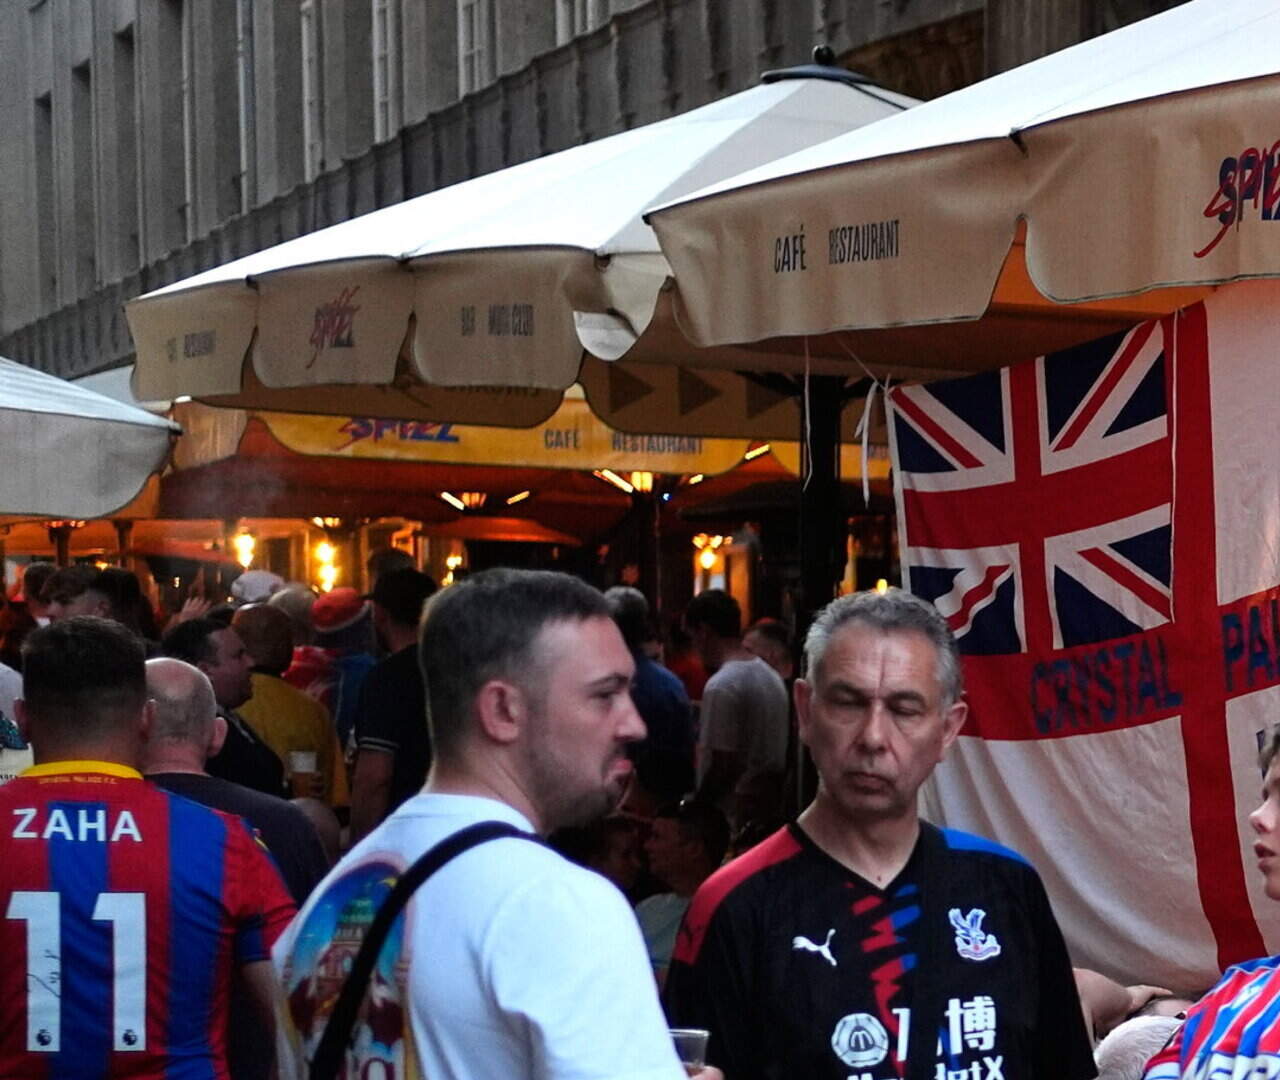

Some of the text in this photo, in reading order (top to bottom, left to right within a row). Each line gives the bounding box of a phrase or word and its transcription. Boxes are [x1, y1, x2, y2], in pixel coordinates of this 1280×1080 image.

[774, 219, 900, 274] CAFÉ RESTAURANT
[1030, 636, 1184, 735] CRYSTAL
[12, 807, 144, 842] ZAHA
[5, 891, 148, 1052] 11
